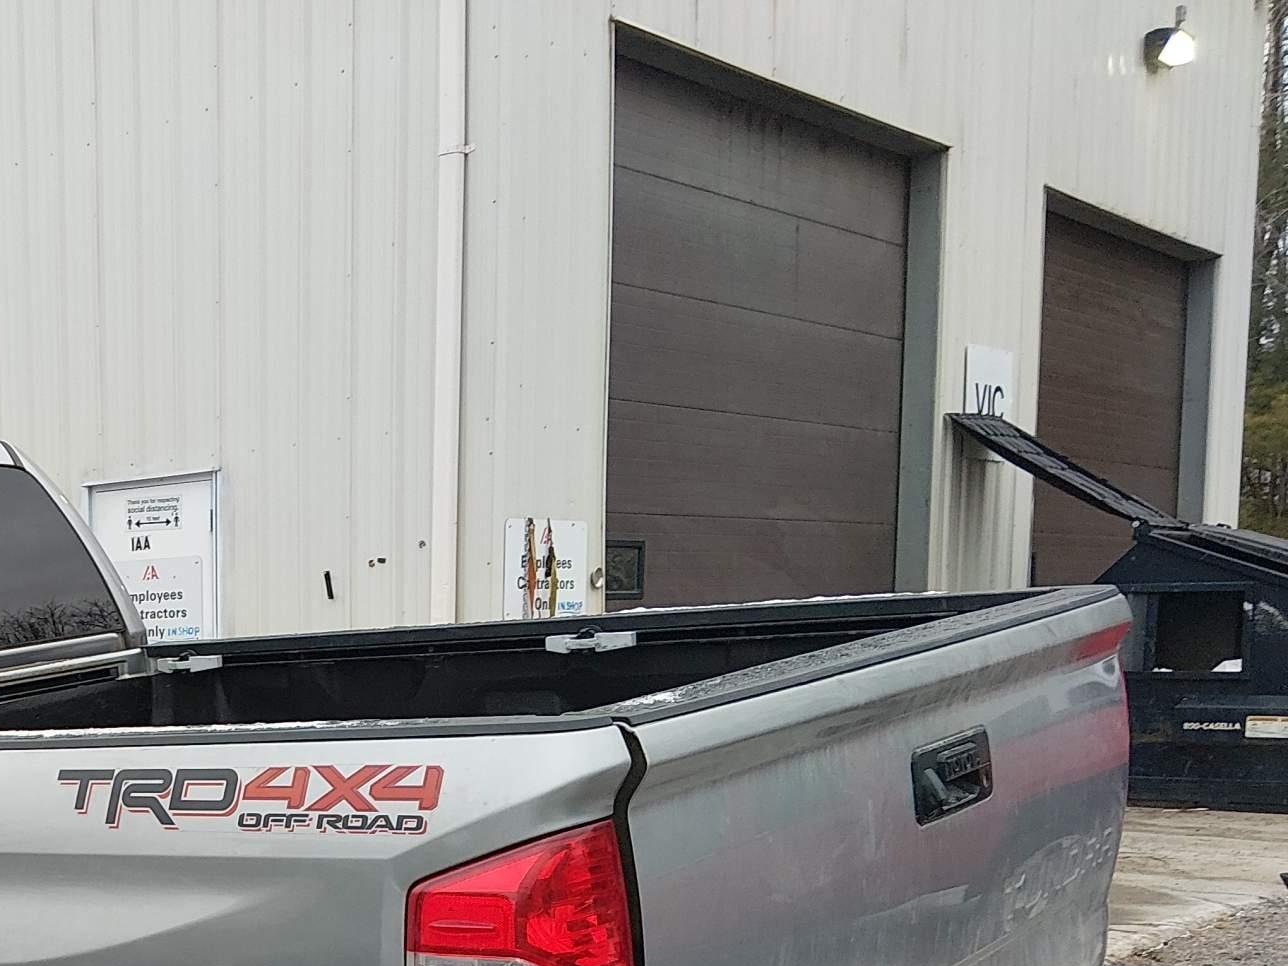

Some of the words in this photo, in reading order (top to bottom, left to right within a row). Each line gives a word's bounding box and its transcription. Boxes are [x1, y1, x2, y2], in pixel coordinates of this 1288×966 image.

[128, 506, 145, 514] social
[131, 536, 151, 552] IAA
[521, 554, 573, 571] Eplees
[517, 576, 575, 590] Ctraors
[130, 590, 183, 604] mployees
[140, 608, 188, 620] tractors
[148, 625, 165, 640] nly
[57, 768, 244, 829] TRD
[237, 812, 314, 832] OFF
[315, 813, 428, 835] ROAD
